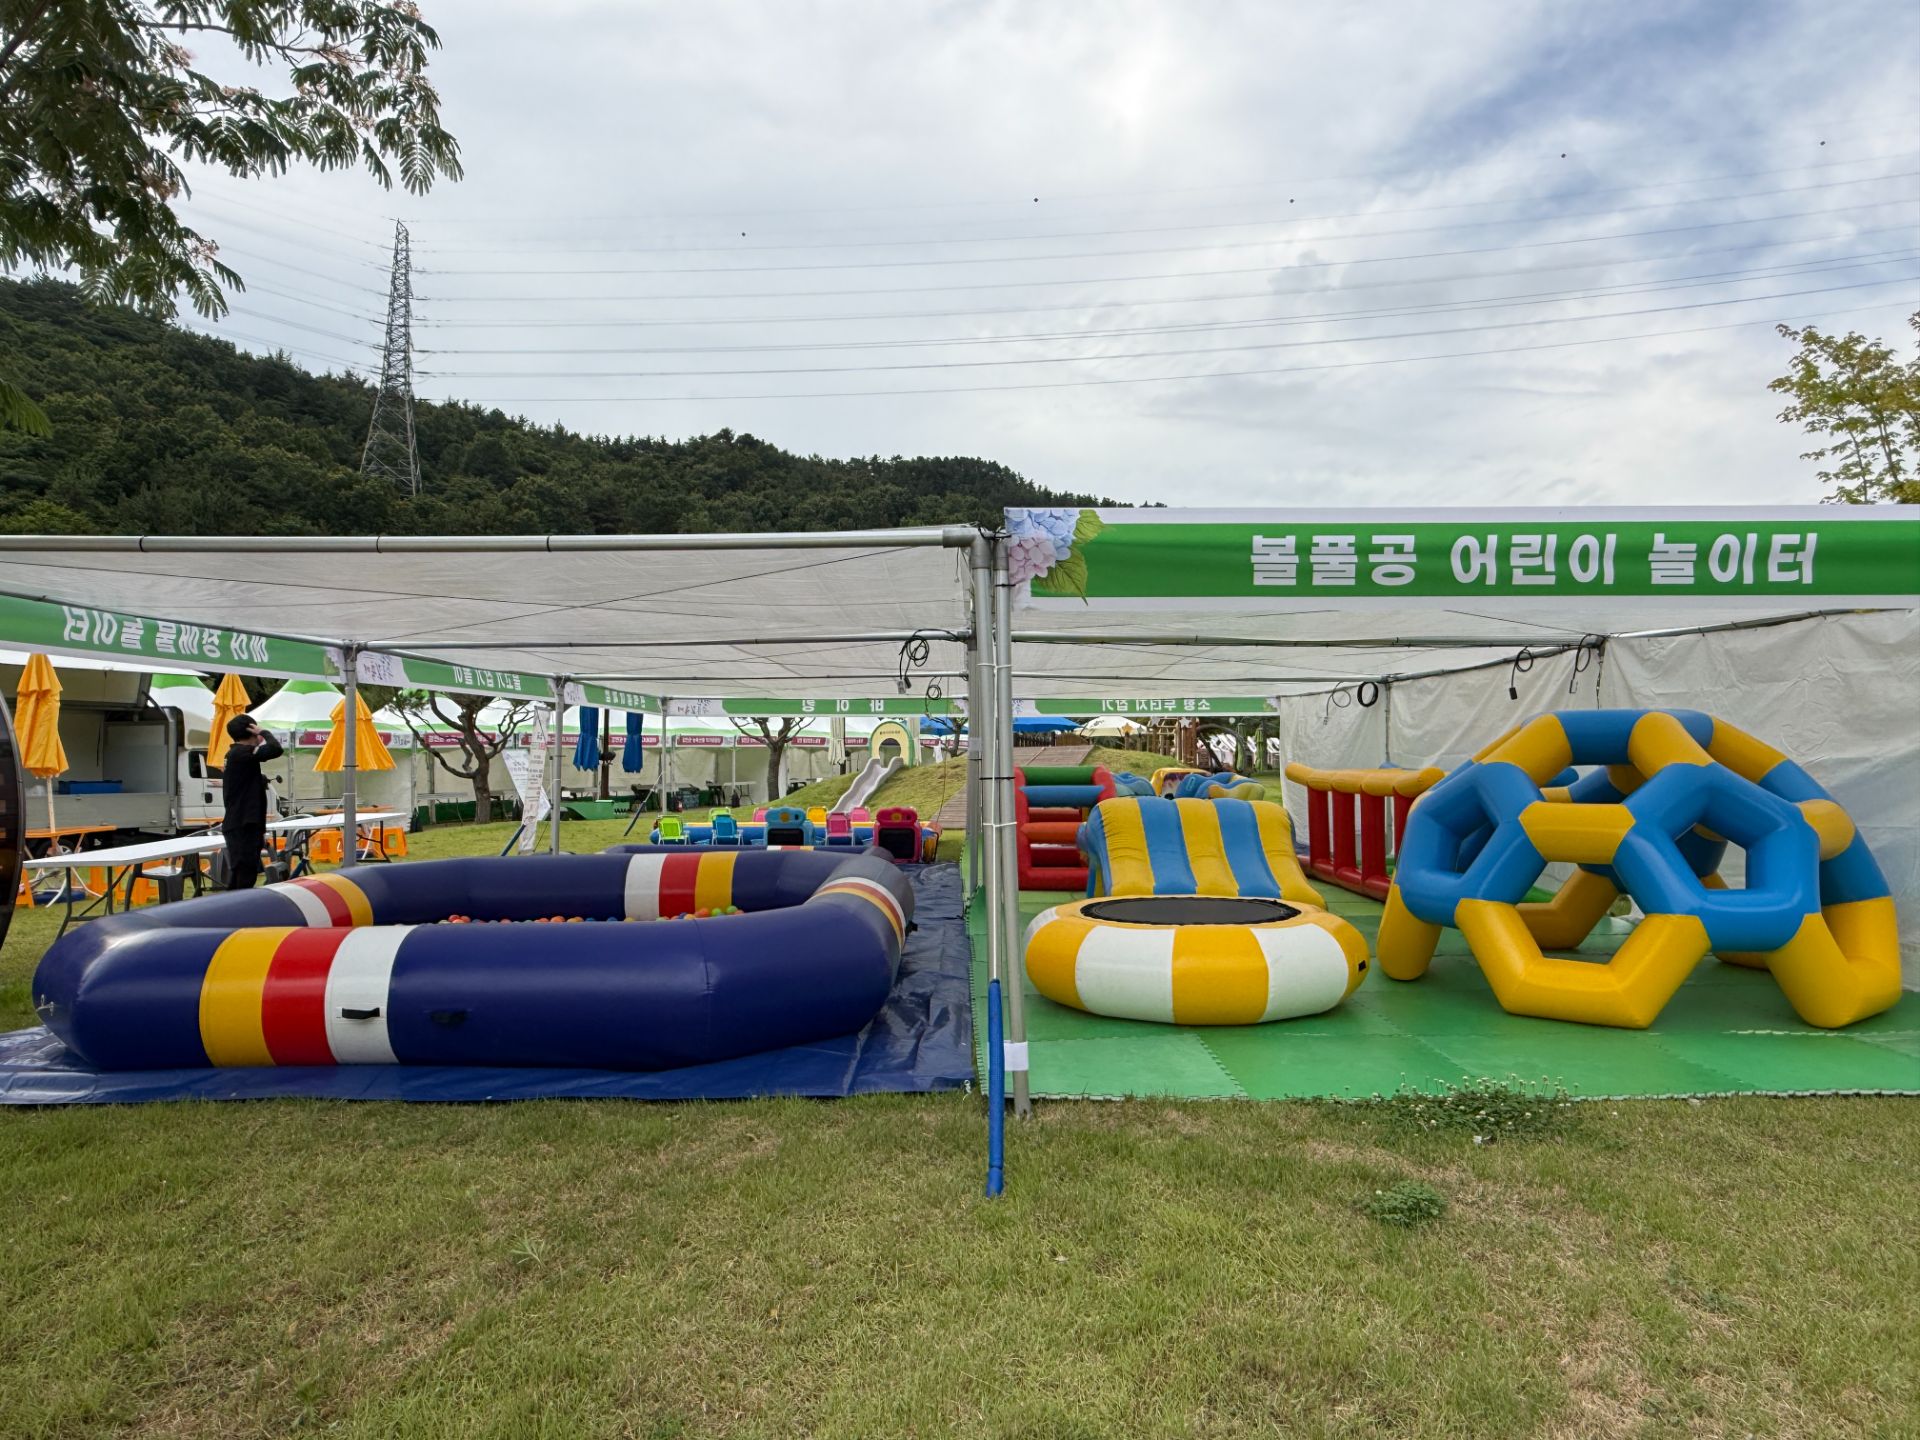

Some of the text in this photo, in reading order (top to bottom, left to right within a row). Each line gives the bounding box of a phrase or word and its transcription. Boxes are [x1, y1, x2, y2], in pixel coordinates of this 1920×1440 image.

[1250, 532, 1818, 586] 볼풀공 어린이 놀이터
